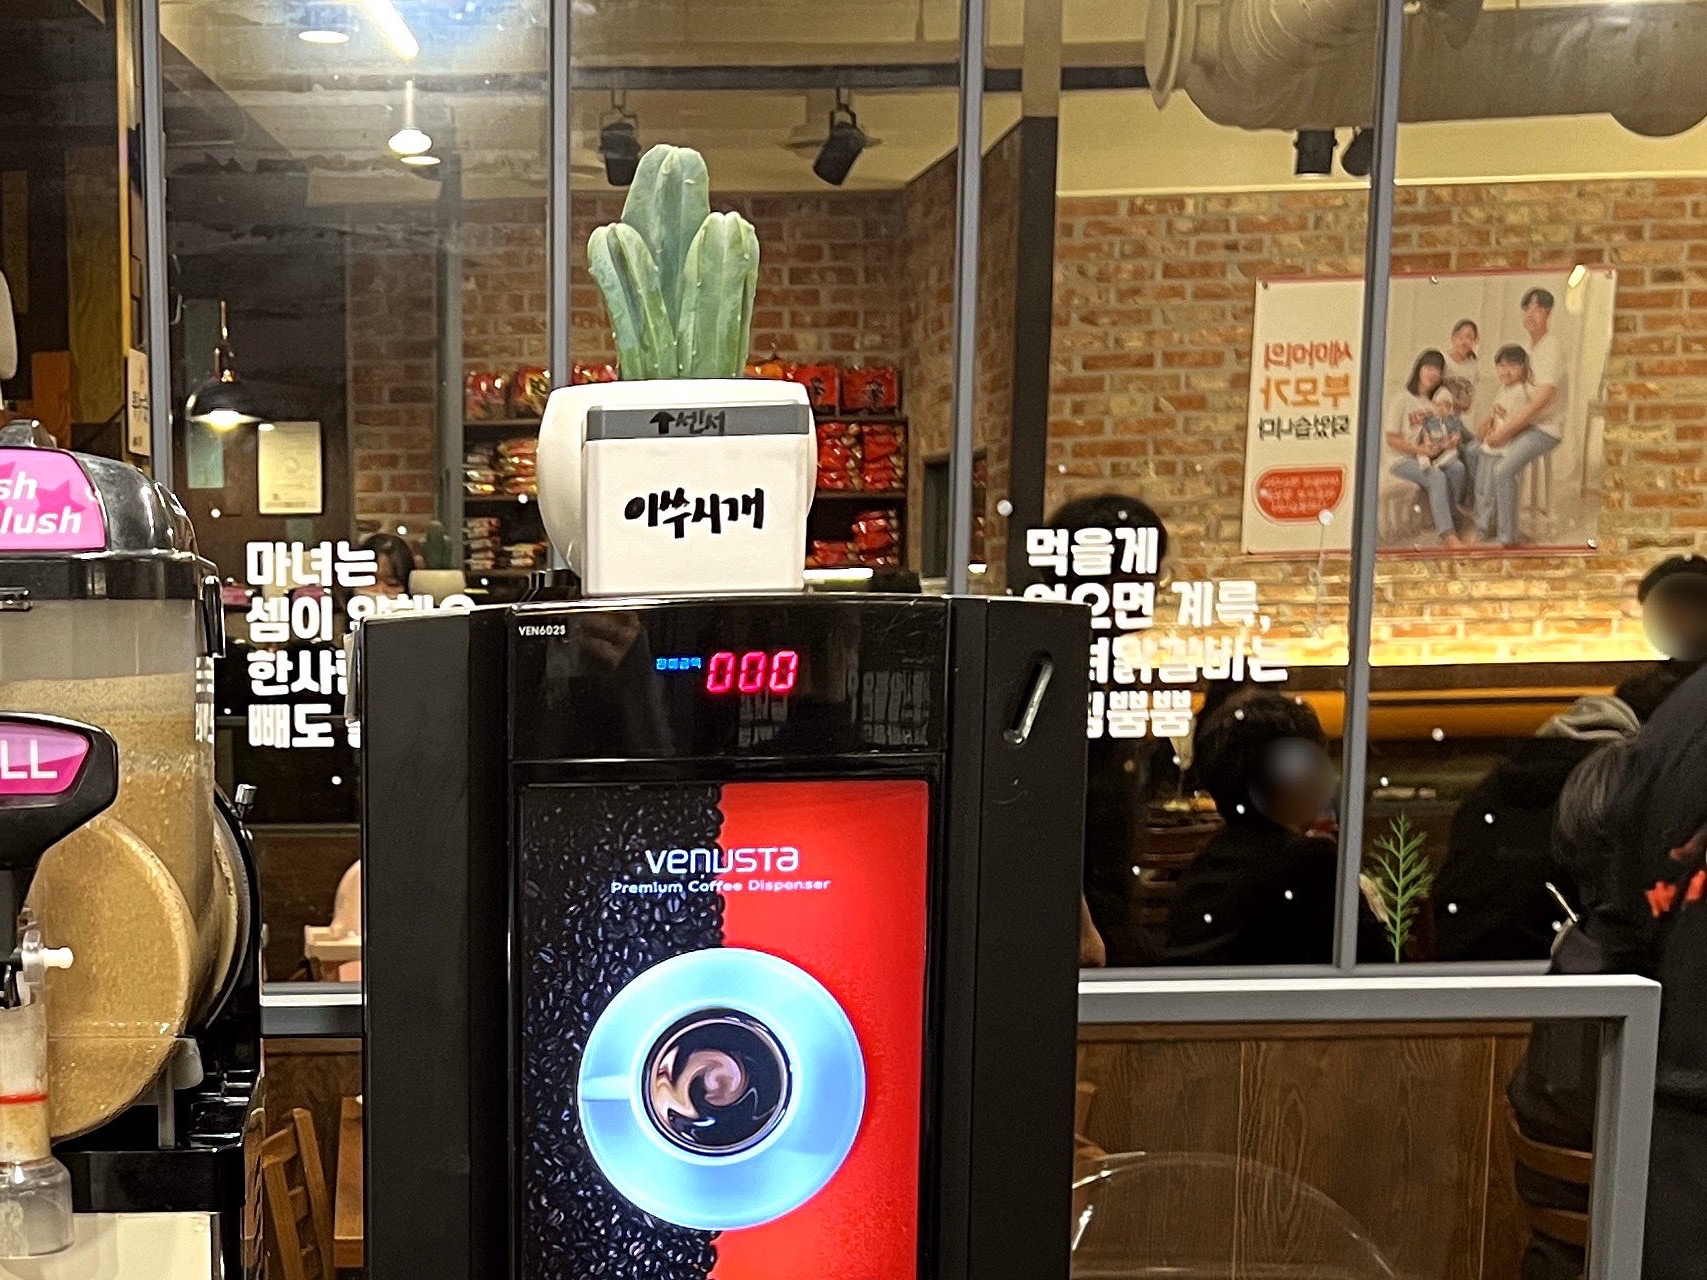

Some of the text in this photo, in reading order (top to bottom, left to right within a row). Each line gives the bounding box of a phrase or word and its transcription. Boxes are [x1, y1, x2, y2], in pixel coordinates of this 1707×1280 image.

[624, 487, 764, 539] 이쑤시개
[246, 541, 378, 587] 마녀는
[1026, 527, 1159, 577] 먹을게
[246, 595, 333, 643] 셈이
[246, 650, 348, 696] 한사
[707, 651, 798, 692] 000
[247, 703, 335, 748] 빼도
[610, 879, 831, 894] Premium Coffee Dispenser
